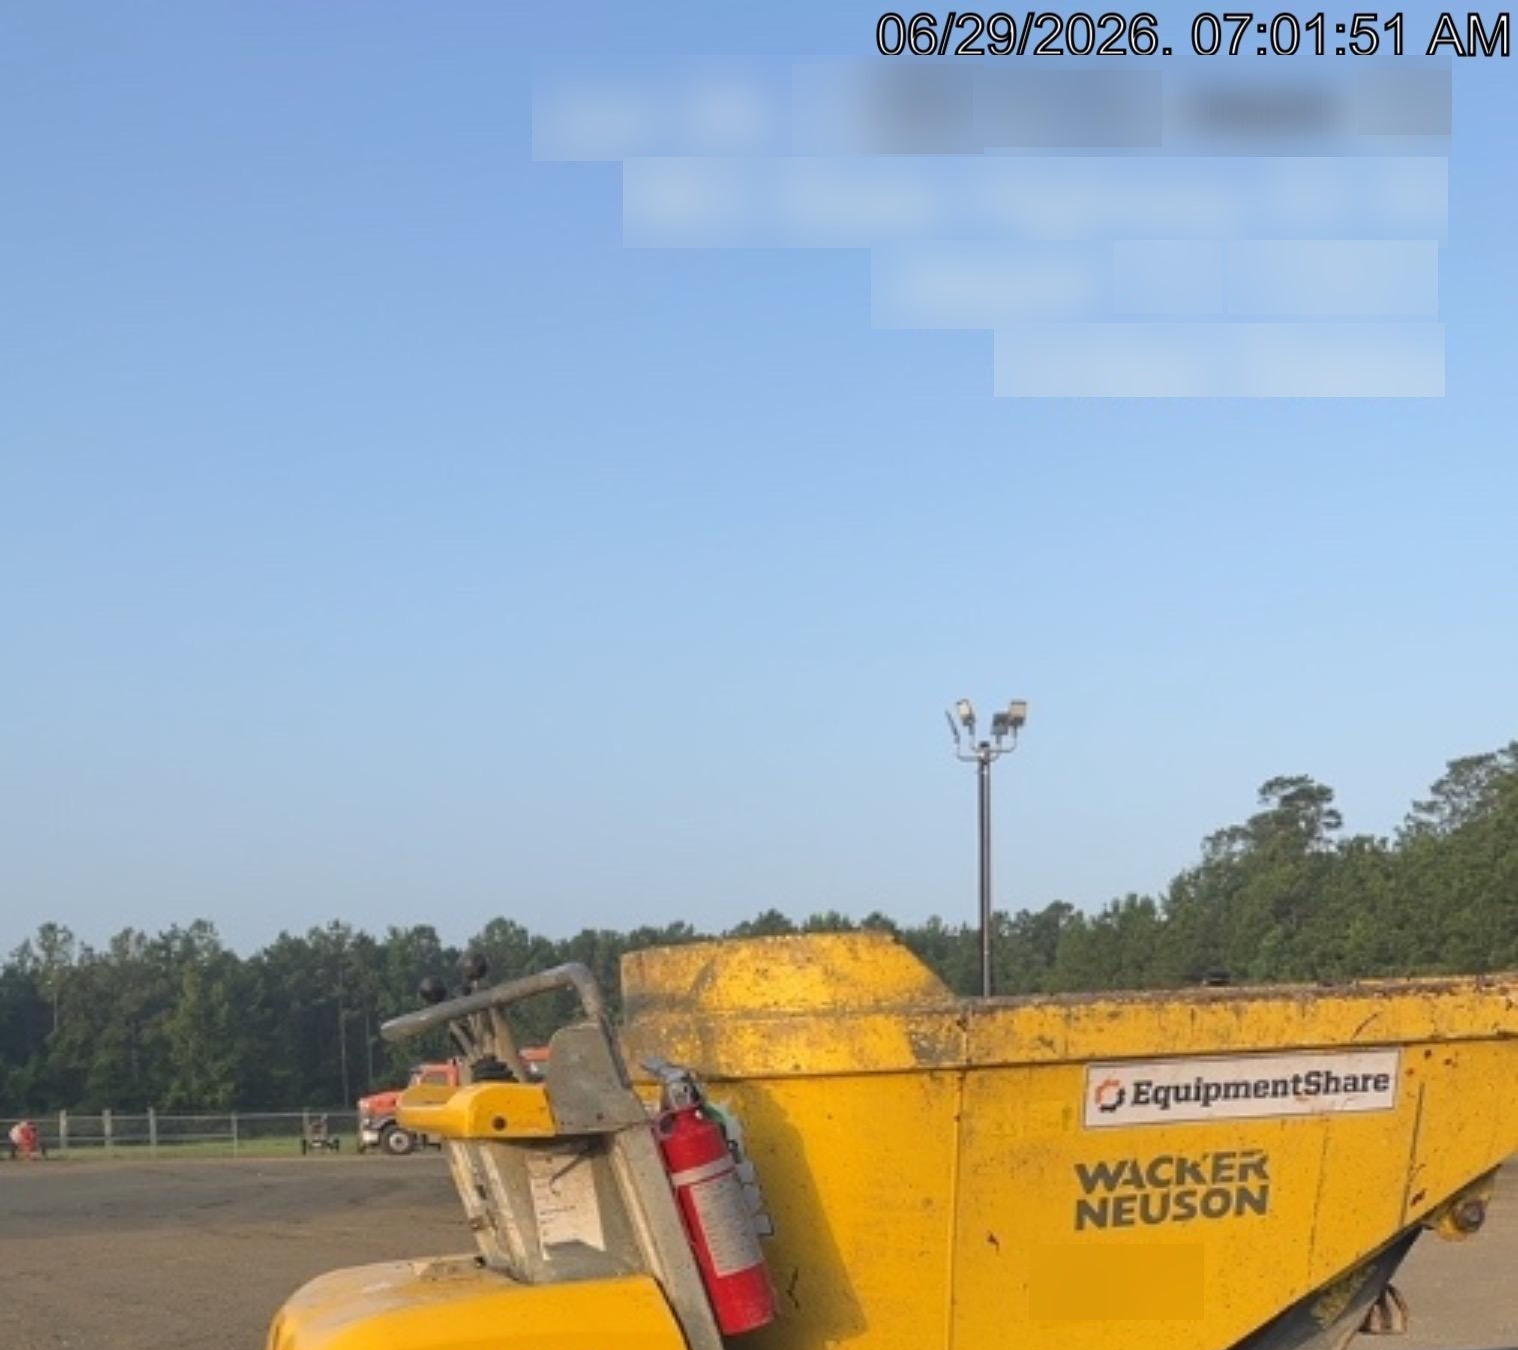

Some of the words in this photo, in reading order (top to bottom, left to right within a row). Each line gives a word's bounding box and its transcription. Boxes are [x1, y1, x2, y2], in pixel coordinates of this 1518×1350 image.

[1131, 1070, 1389, 1110] EquipmentShare
[1073, 1149, 1270, 1195] WACKER
[1073, 1184, 1270, 1231] NEUSON
